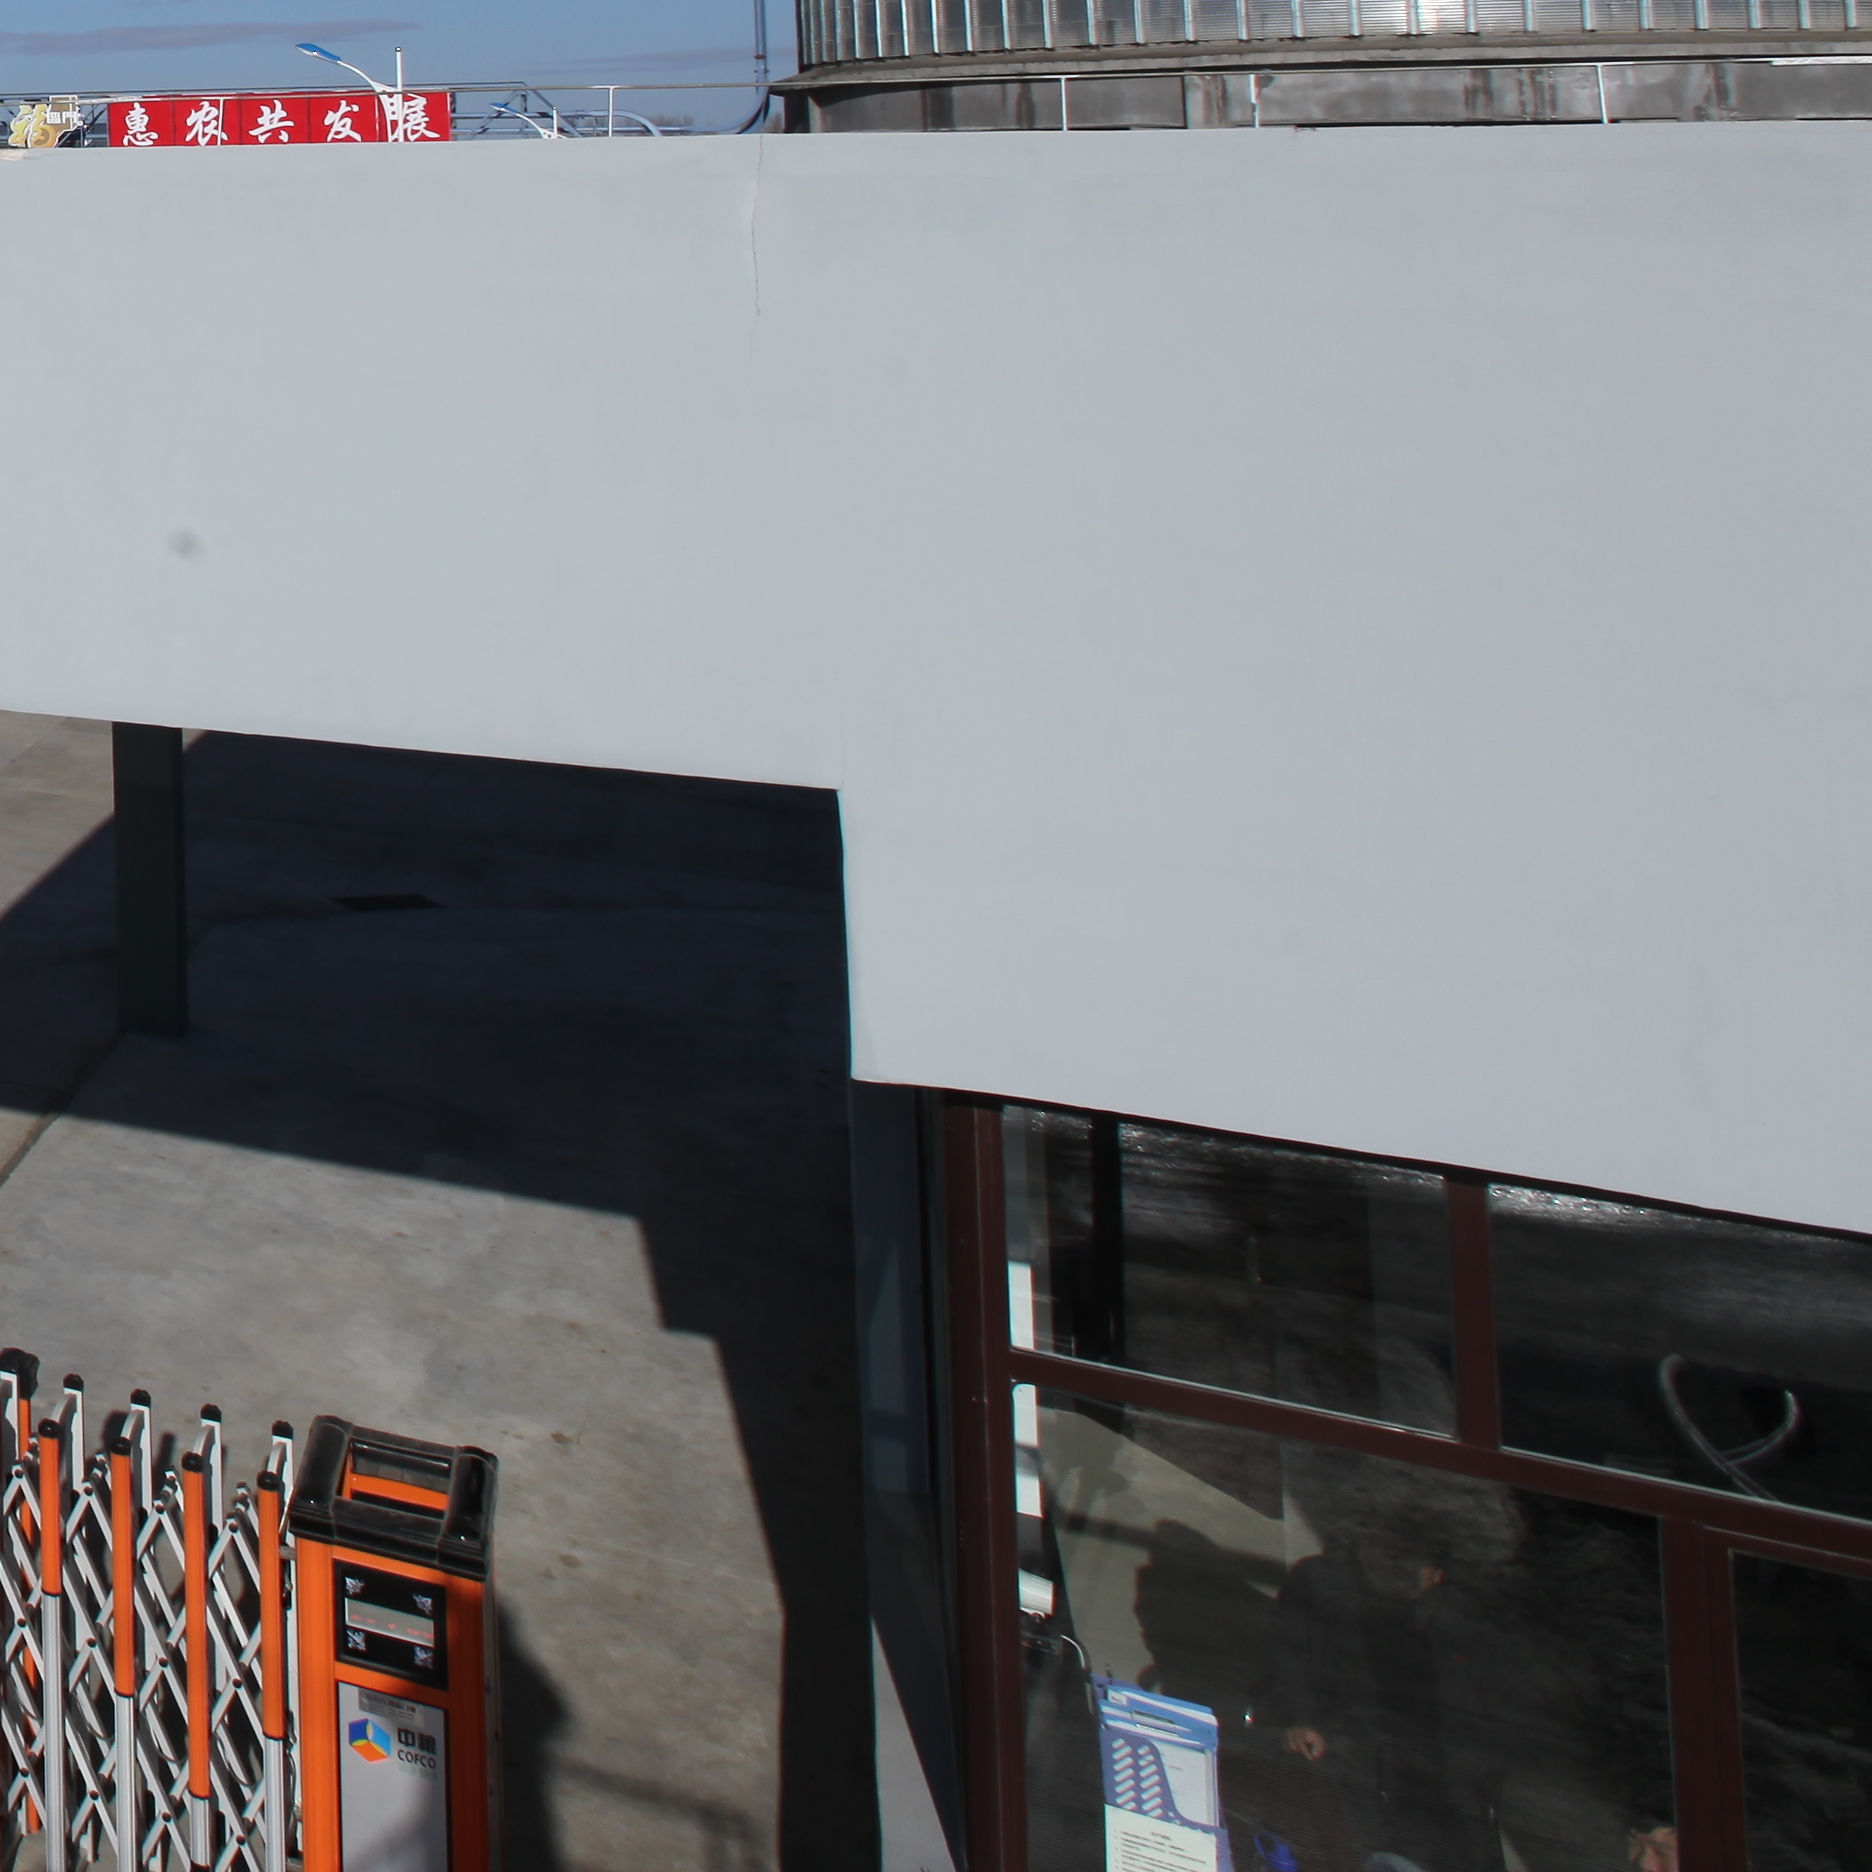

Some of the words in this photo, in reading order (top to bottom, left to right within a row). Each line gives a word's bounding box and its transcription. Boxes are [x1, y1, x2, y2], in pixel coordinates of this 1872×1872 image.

[122, 93, 441, 147] 惠农共发展
[397, 1748, 436, 1769] COFCO
